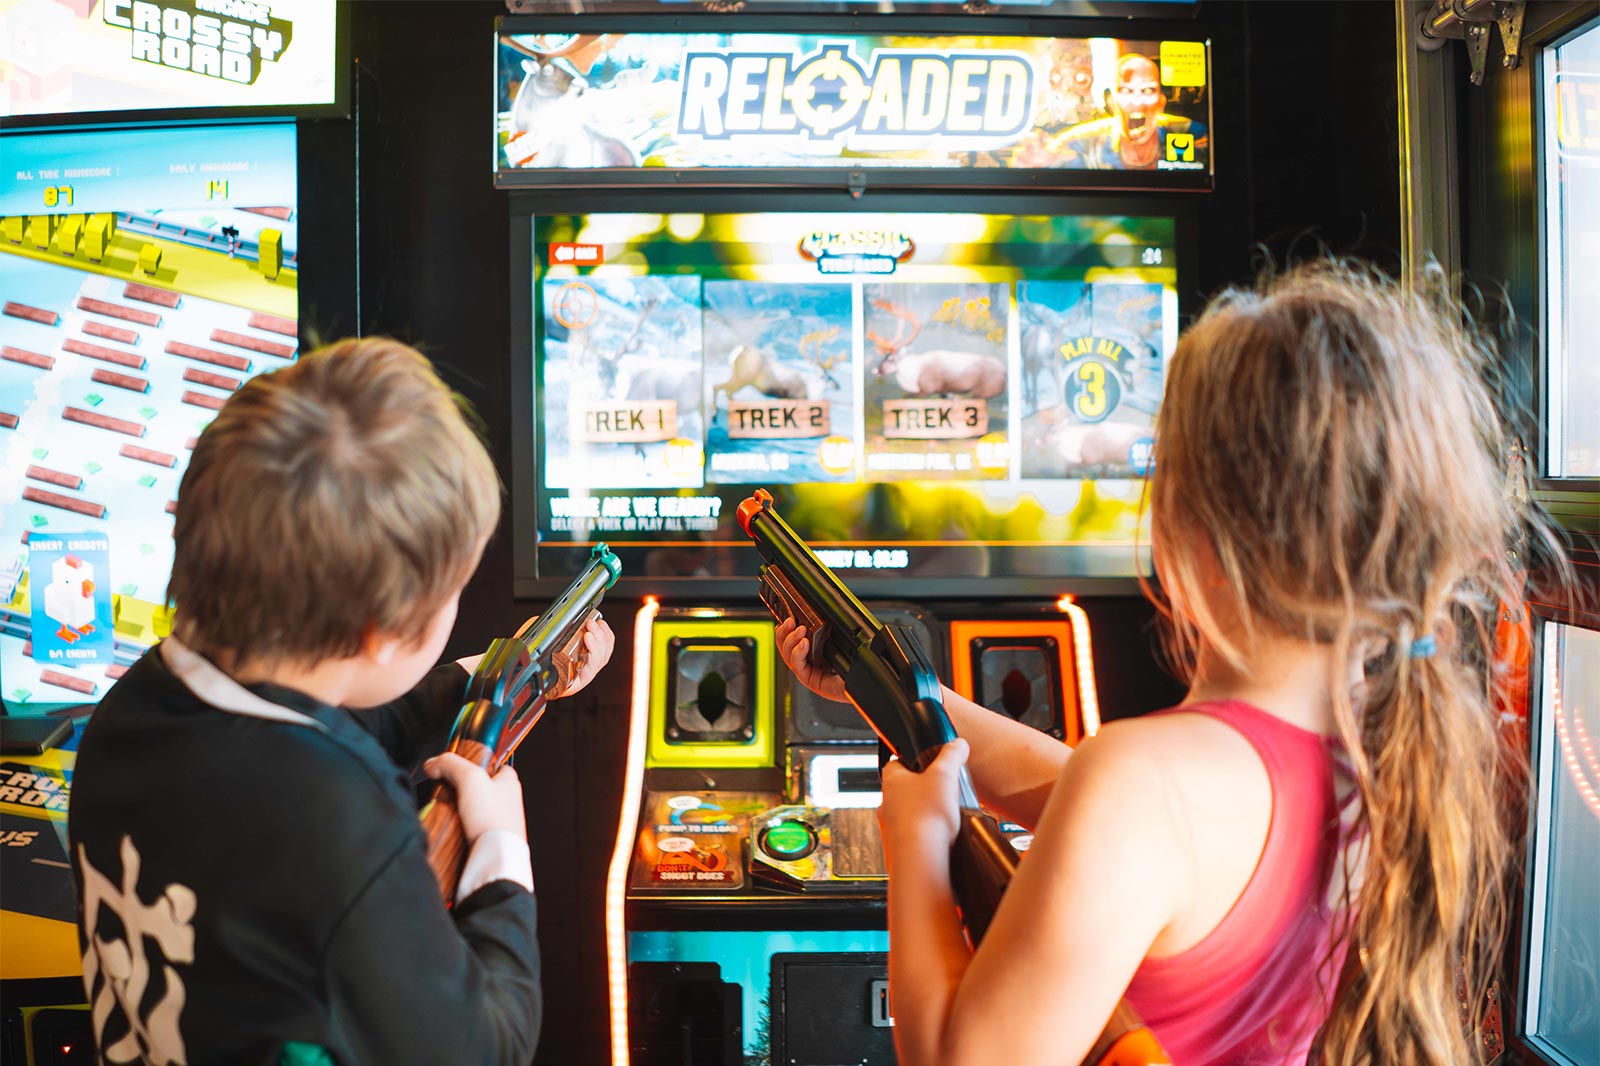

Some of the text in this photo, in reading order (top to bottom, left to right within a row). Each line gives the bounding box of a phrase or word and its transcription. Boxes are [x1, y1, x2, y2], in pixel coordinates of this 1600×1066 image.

[103, 0, 283, 61] CROSSY
[132, 29, 252, 85] ROAD
[681, 50, 1030, 136] RELOADED
[16, 170, 33, 180] ALL
[39, 169, 60, 179] TIME
[44, 185, 73, 207] 87
[206, 179, 229, 200] 14
[1060, 337, 1123, 363] PLAY ALL
[1078, 360, 1107, 417] 3
[585, 409, 645, 433] TREK
[735, 406, 824, 430] TREK 2
[891, 406, 979, 430] TREK 3
[29, 540, 108, 551] INSERT CREDITS
[689, 825, 700, 833] TO
[702, 825, 739, 833] RELOAD
[657, 864, 688, 872] DON'T
[660, 871, 725, 880] SHOOT DOES
